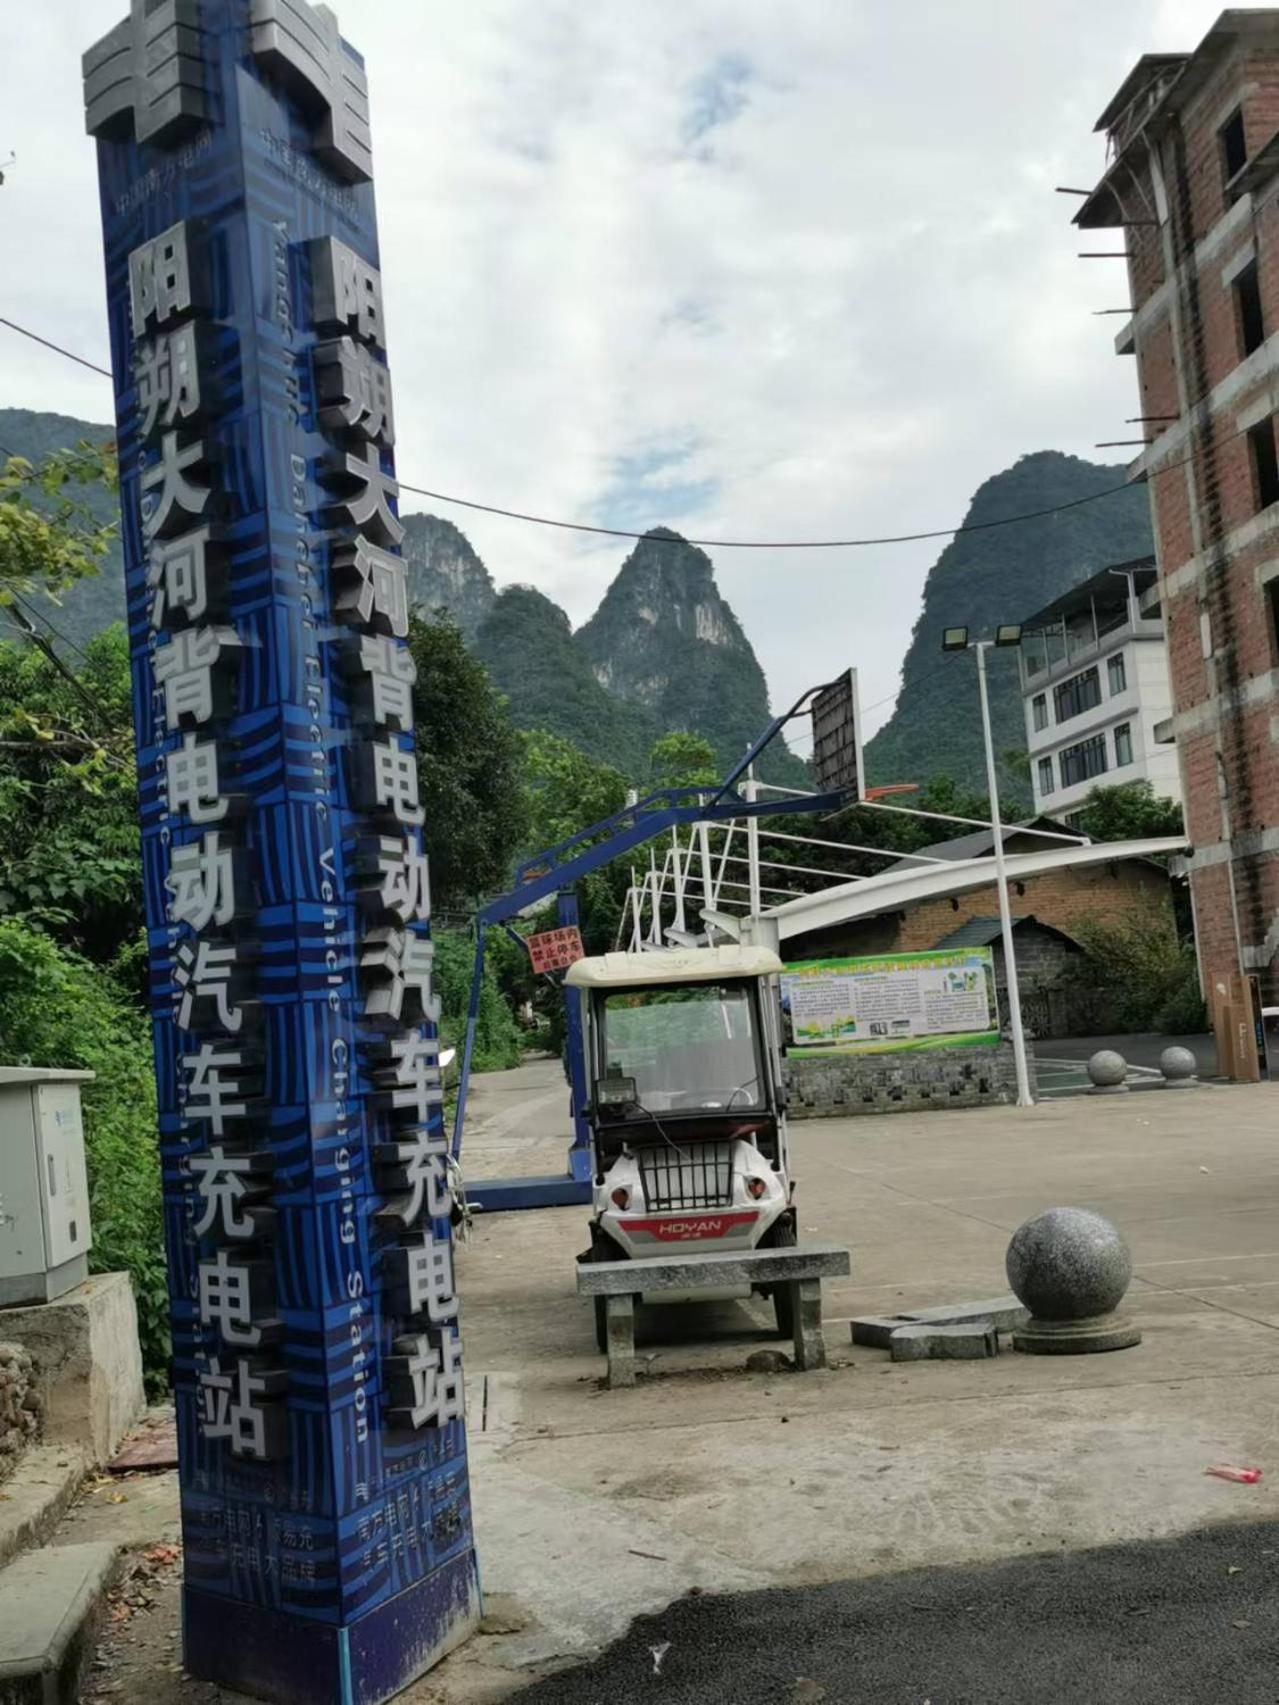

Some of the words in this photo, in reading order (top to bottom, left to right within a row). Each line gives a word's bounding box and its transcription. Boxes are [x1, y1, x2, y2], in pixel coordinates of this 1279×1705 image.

[127, 220, 267, 1459] 阳朔大河背电动汽车充电站
[304, 656, 329, 823] Electric
[318, 847, 344, 1012] Vehicle
[331, 1038, 356, 1244] Charging
[346, 1270, 369, 1444] Station
[328, 235, 467, 1430] 阳朔大河背电动汽车充电站
[659, 1221, 722, 1234] HOYAN
